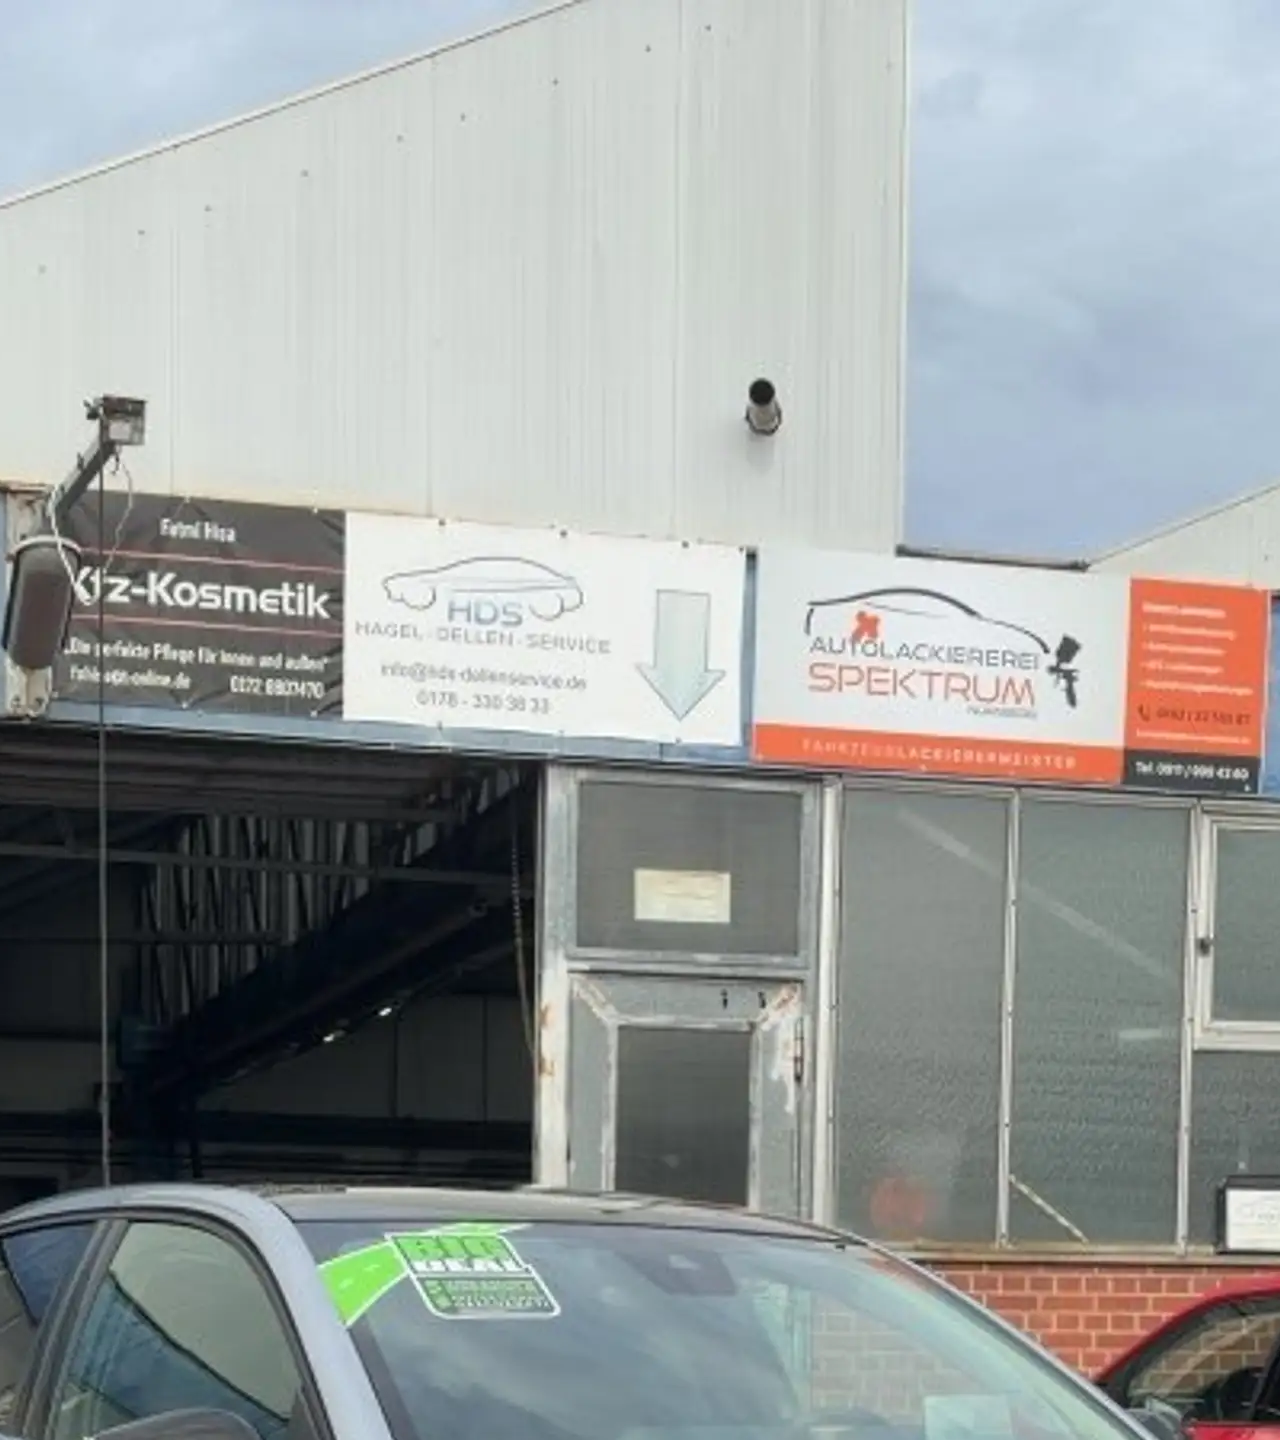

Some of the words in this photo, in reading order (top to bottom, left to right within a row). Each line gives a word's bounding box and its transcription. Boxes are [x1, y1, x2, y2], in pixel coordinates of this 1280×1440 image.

[447, 600, 523, 627] HDS
[354, 620, 423, 641] HAGEL
[437, 627, 514, 648] DELLEN
[526, 633, 611, 654] SERVICE
[809, 634, 1040, 671] AUTOLACKIEREREI
[807, 662, 1036, 708] SPEKTRUM
